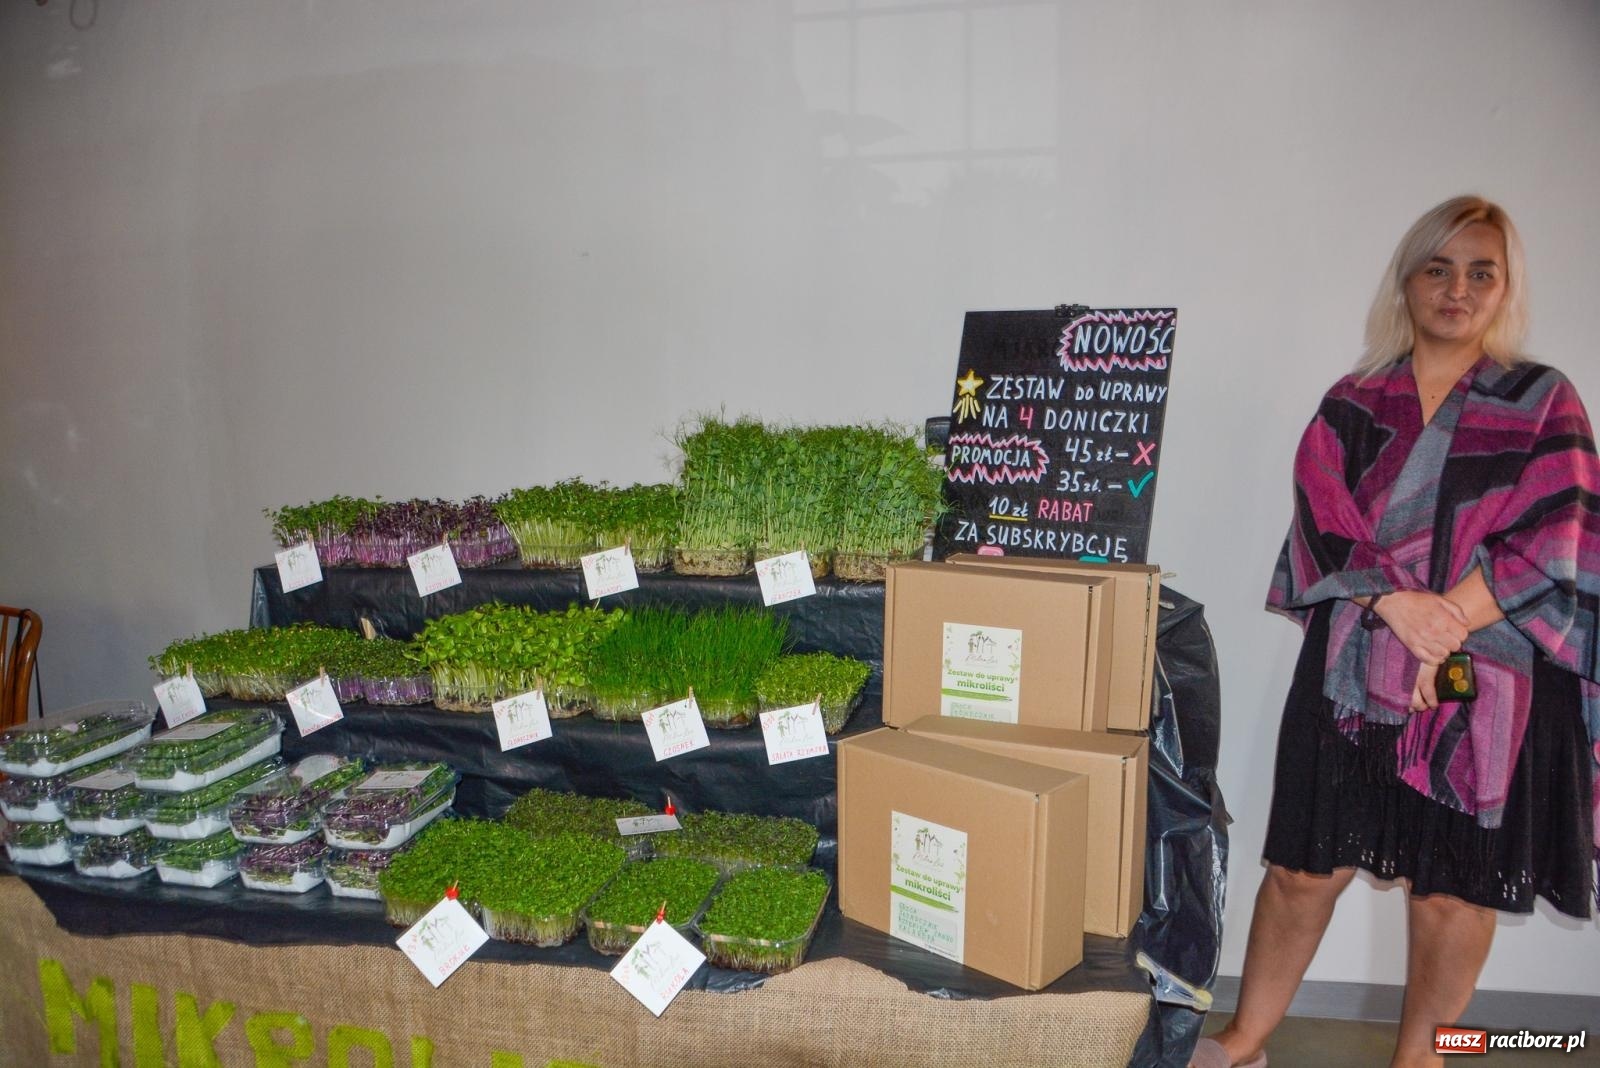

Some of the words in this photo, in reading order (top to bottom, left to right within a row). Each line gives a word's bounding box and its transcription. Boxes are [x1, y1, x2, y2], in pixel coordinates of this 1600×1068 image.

[1074, 319, 1176, 354] NOWOŚĆ
[986, 376, 1064, 400] ZESTAW
[1100, 382, 1167, 403] UPRAWY
[982, 405, 1008, 427] NA
[1019, 406, 1034, 429] 4
[1044, 408, 1149, 434] DONICZKI
[951, 445, 1031, 468] PROMOCJA
[1065, 438, 1093, 462] 45
[1056, 470, 1085, 492] 35
[989, 496, 1009, 515] 10
[1038, 499, 1093, 522] RABAT
[955, 520, 978, 543] ZA
[986, 525, 1128, 563] SUBSKRYBCJĘ
[947, 668, 973, 678] Zestaw
[976, 671, 985, 679] do
[957, 680, 1005, 692] mikroliści
[896, 863, 920, 878] Zestaw
[922, 872, 932, 882] do
[905, 878, 951, 901] mikroliści
